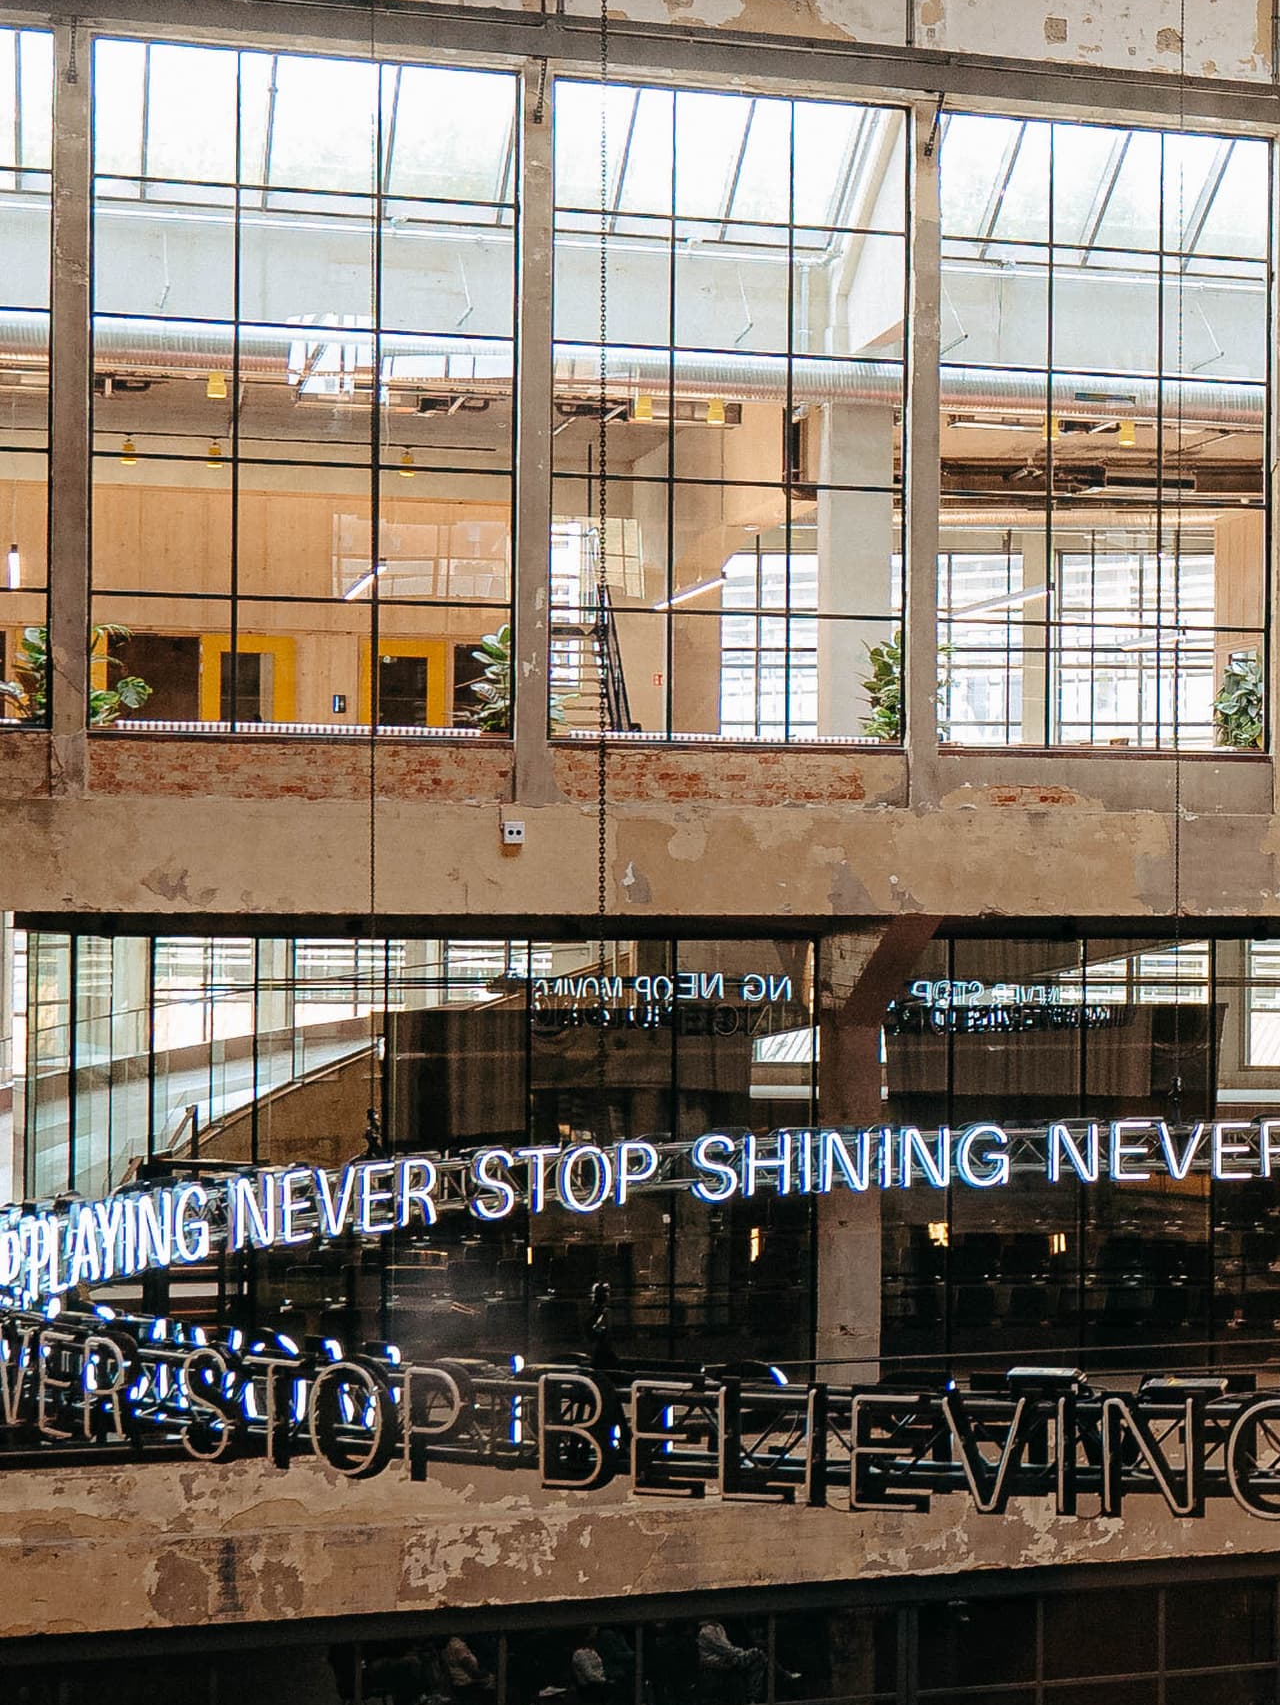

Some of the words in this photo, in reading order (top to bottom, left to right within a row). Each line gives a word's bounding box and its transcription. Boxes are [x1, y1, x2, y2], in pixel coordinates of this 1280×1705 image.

[230, 1156, 437, 1250] NEVER
[471, 1140, 659, 1221] STOP
[692, 1122, 1011, 1201] SHINING
[182, 1347, 463, 1479] STOP
